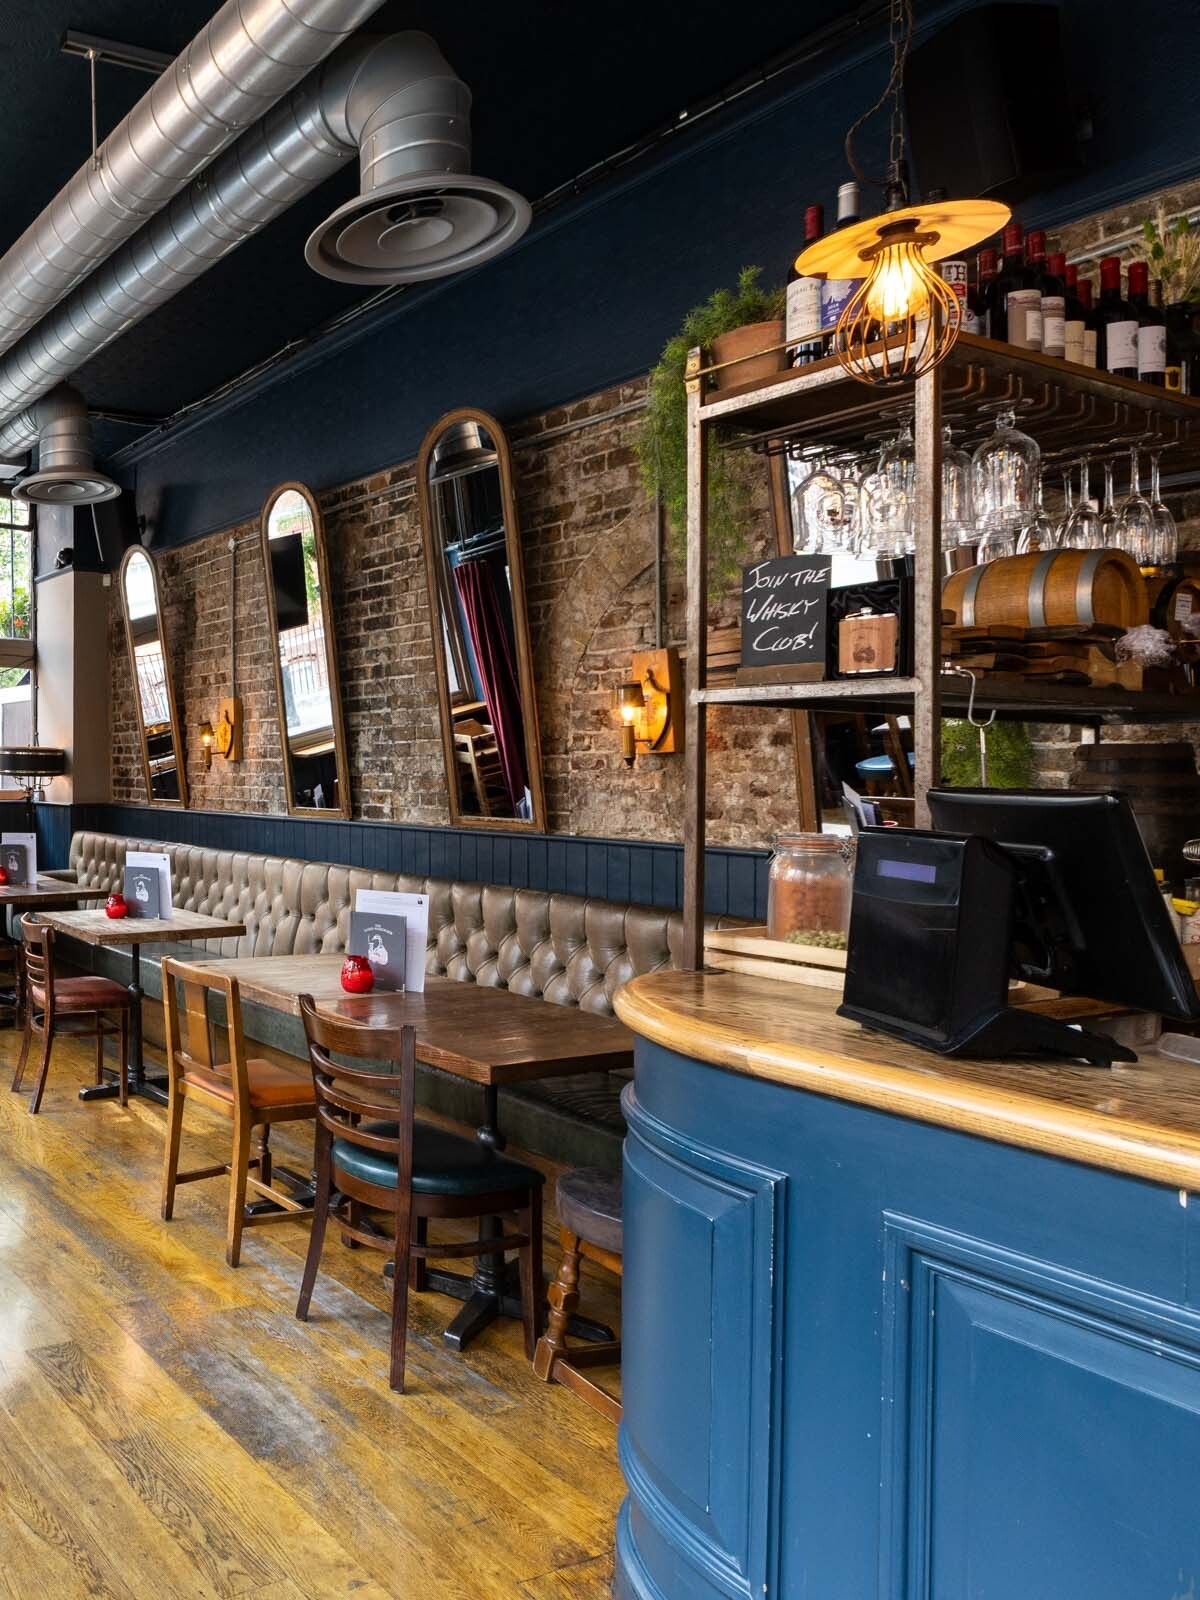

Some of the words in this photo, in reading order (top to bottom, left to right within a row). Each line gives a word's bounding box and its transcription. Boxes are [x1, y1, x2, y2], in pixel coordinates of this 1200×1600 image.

[744, 561, 789, 593] JOIN
[790, 567, 832, 587] THE
[746, 594, 820, 623] WHISKY
[752, 621, 819, 651] CLUB!
